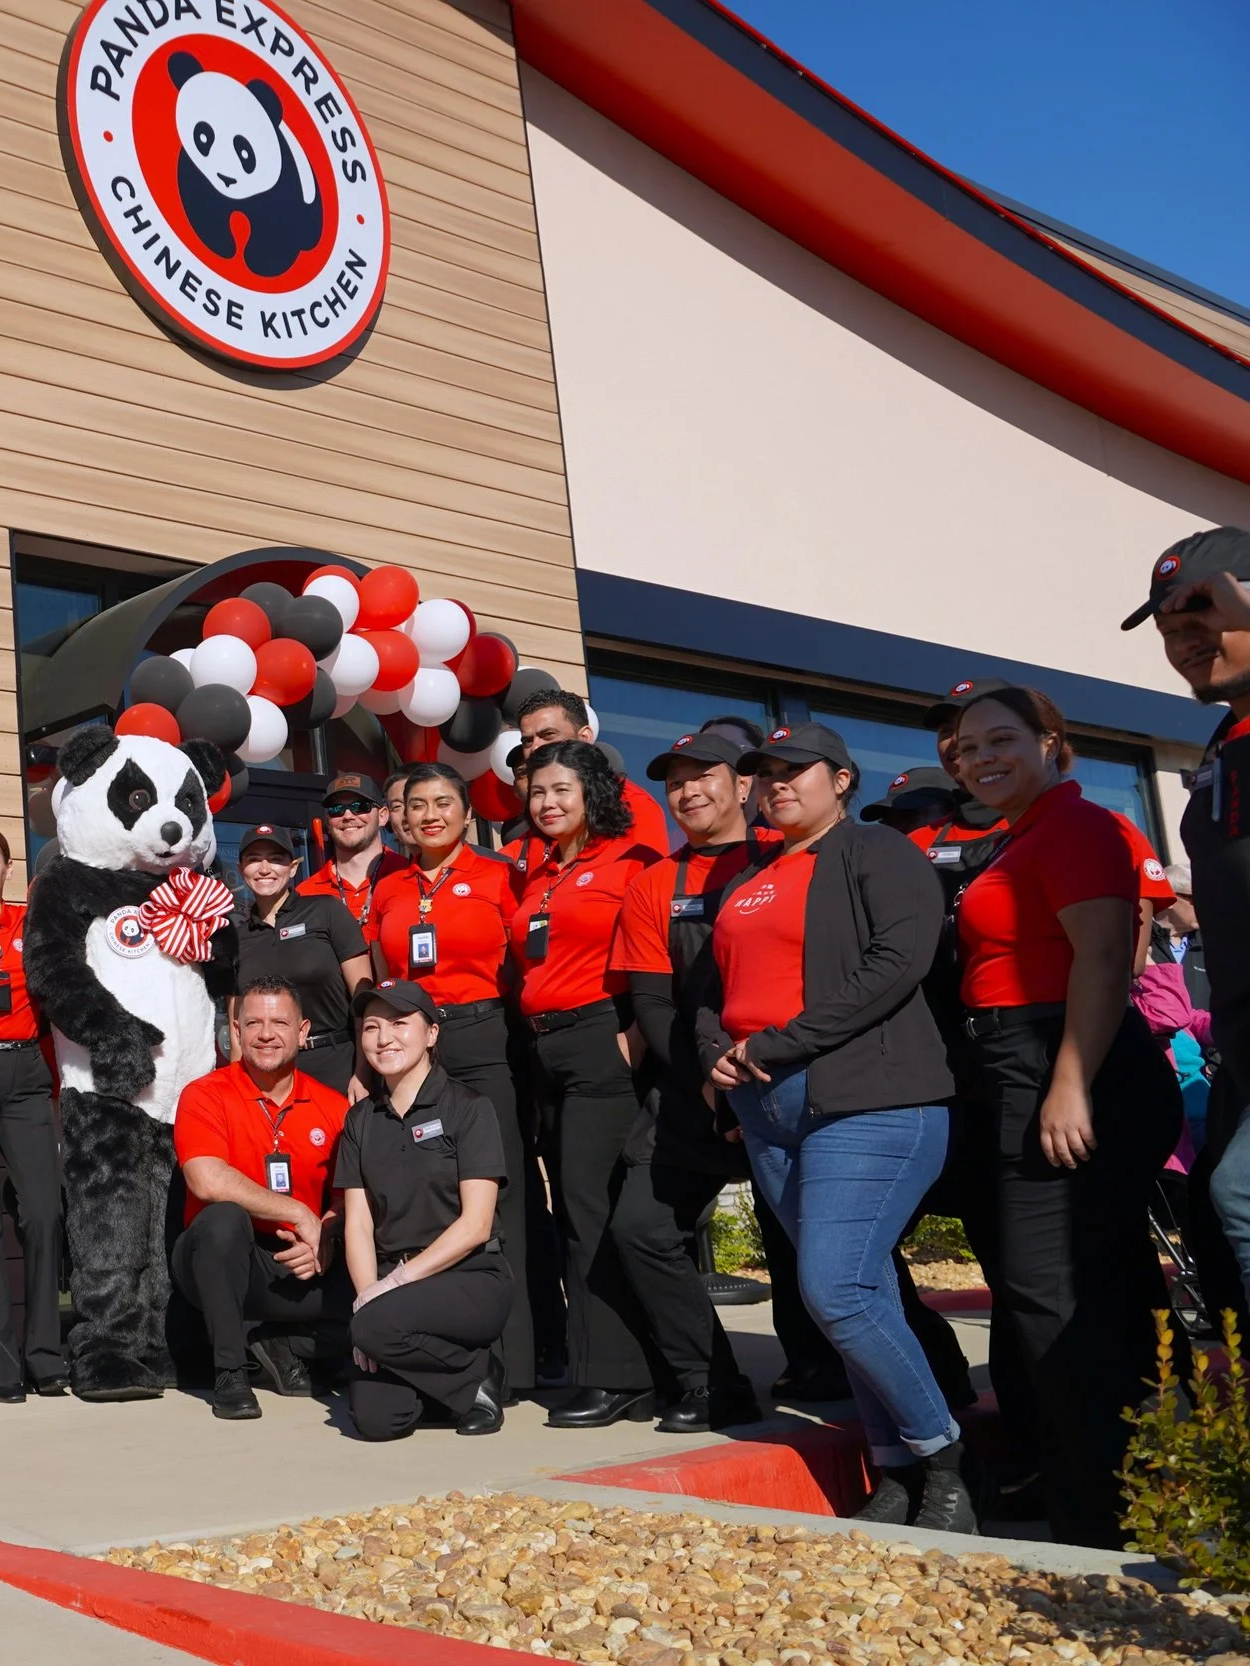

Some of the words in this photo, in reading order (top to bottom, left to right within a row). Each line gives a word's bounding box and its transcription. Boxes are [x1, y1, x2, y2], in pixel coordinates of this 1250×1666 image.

[90, 0, 202, 102] PANDA
[215, 0, 367, 184] EXPRESS
[111, 176, 244, 331] CHINESE
[260, 248, 367, 340] KITCHEN
